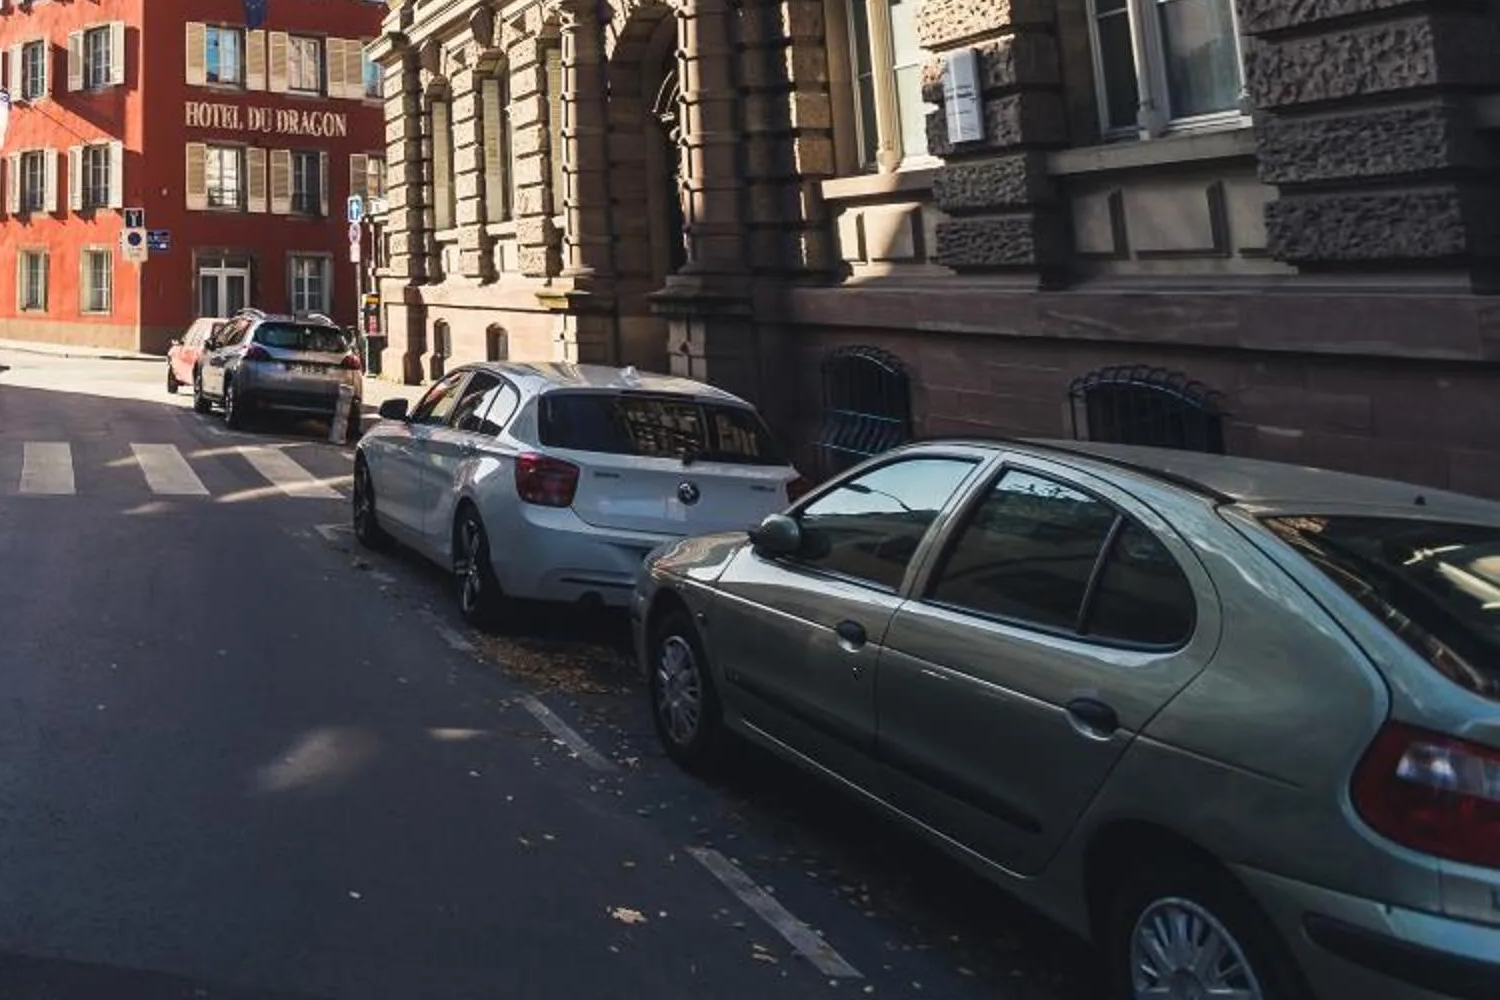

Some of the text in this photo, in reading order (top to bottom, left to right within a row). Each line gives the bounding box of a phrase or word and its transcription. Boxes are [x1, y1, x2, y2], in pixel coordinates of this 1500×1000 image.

[185, 101, 347, 137] HOTEL DU DRAGON
